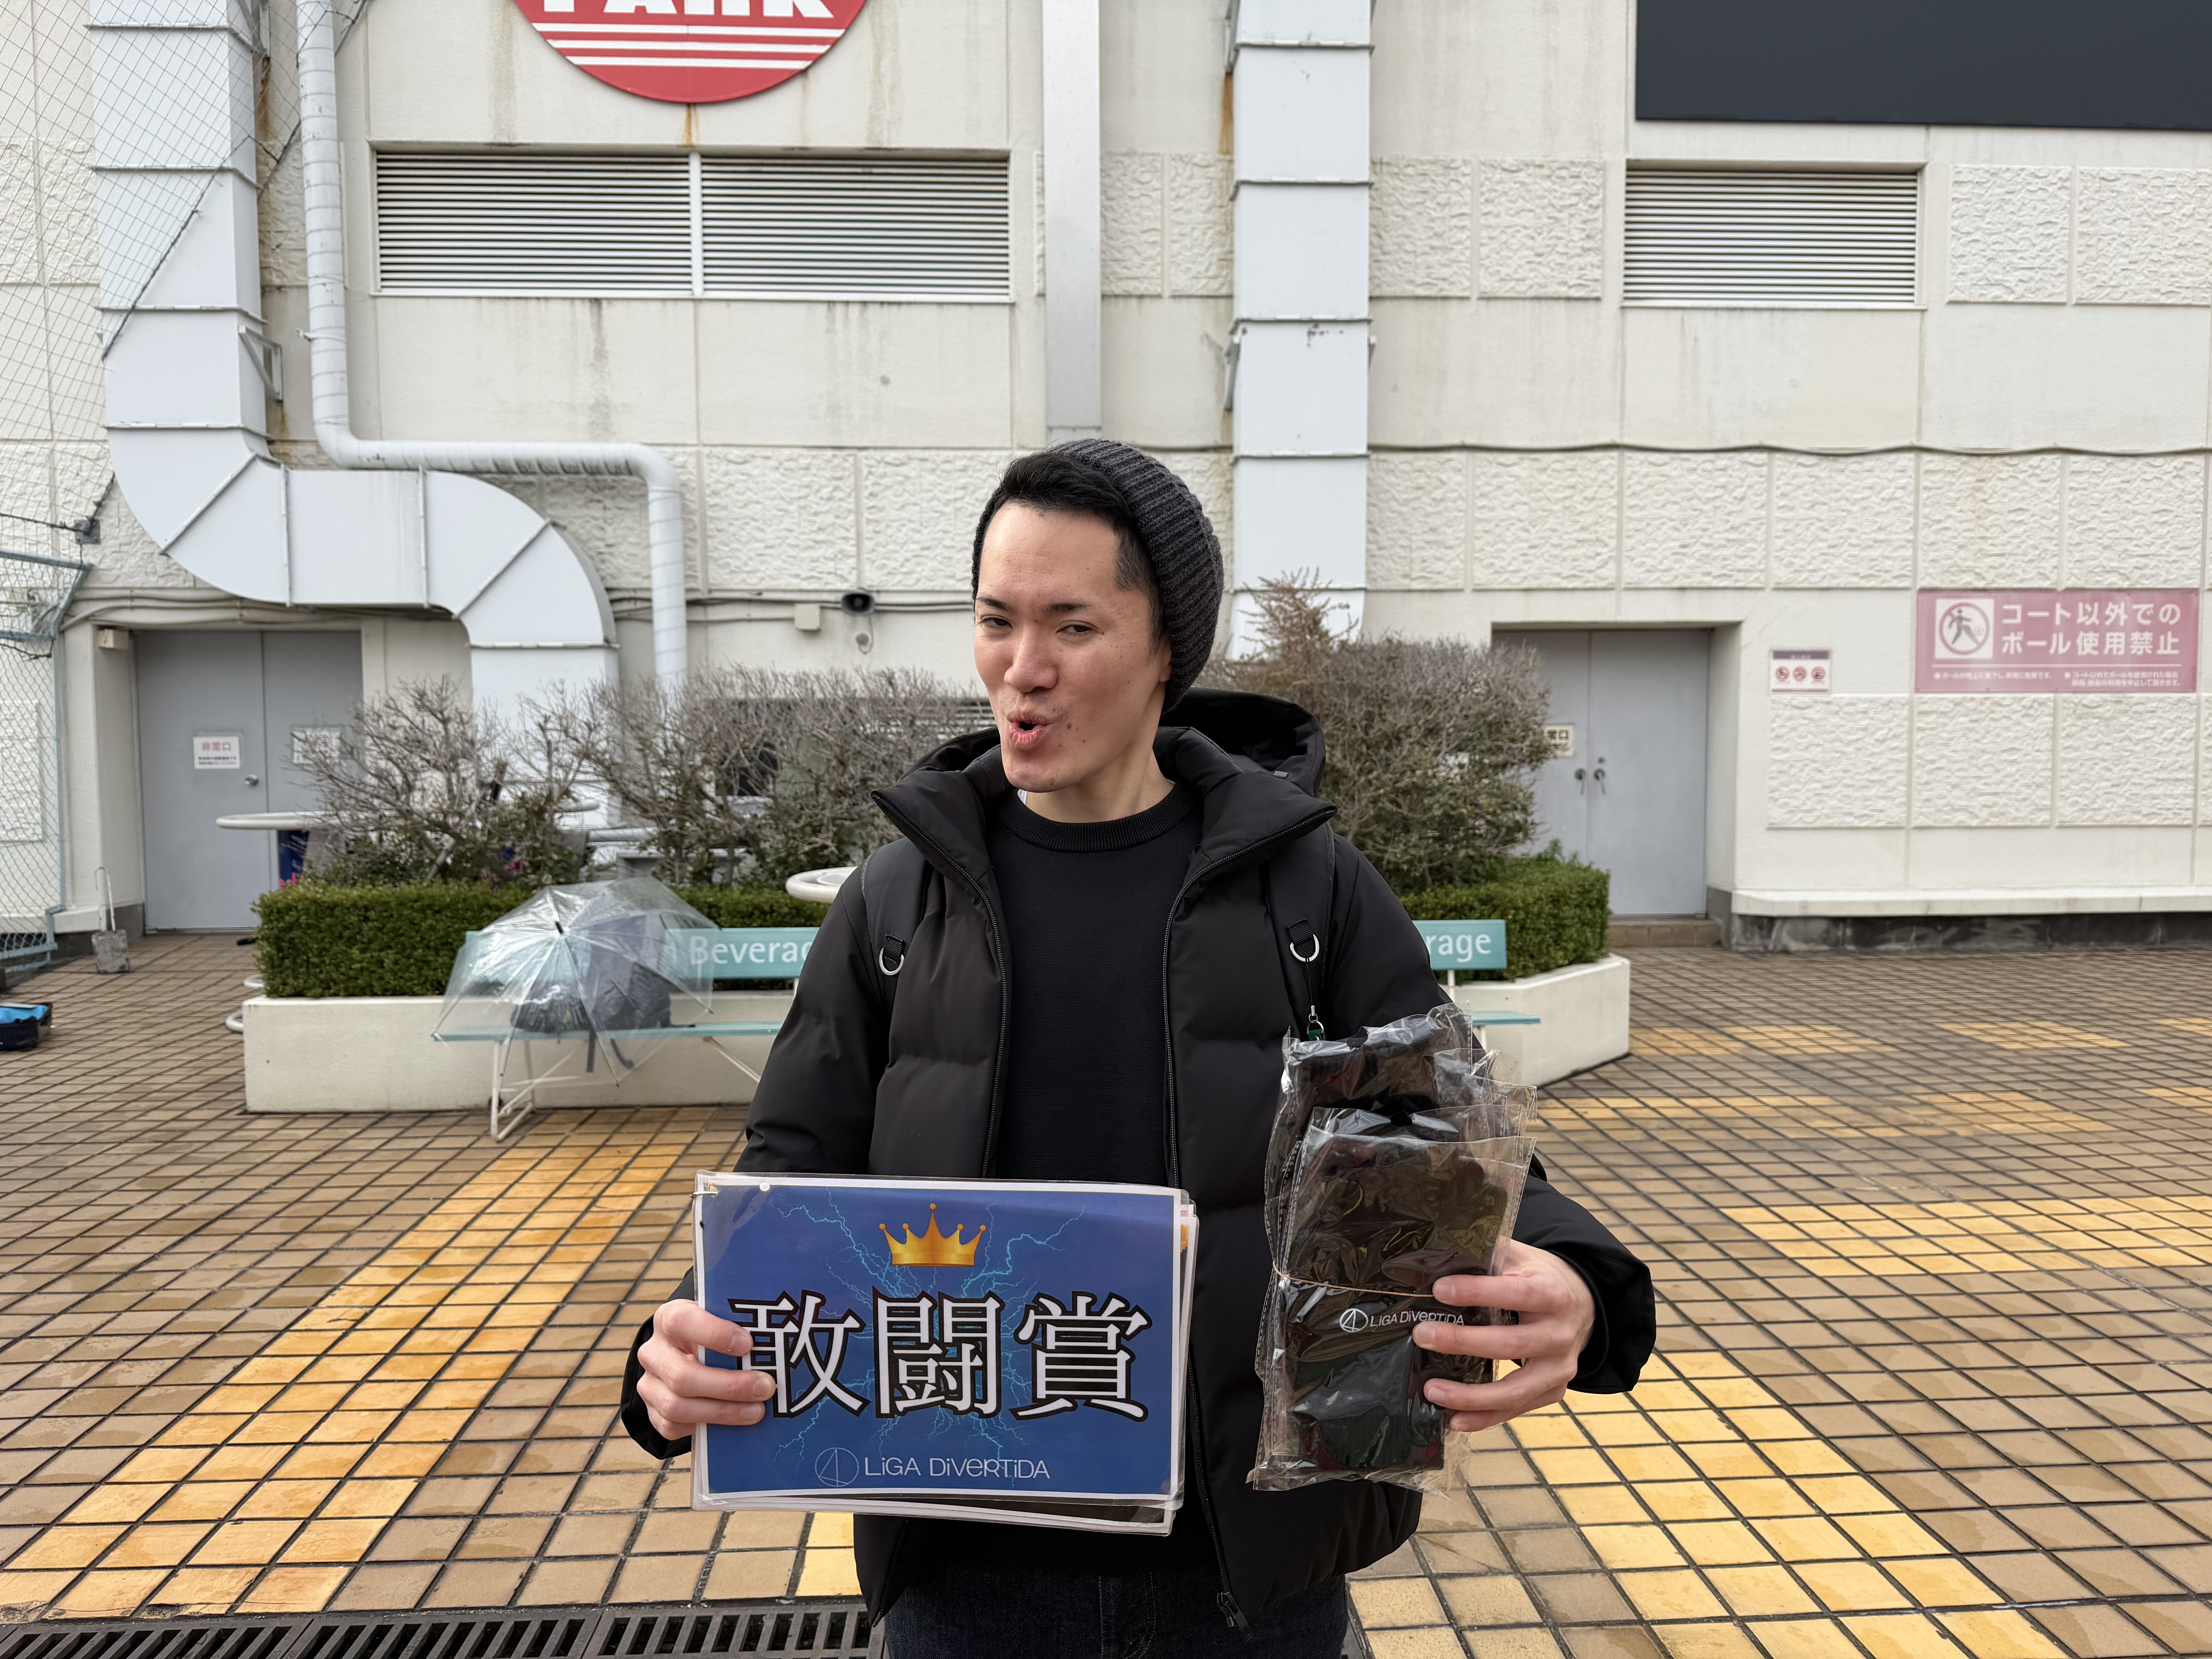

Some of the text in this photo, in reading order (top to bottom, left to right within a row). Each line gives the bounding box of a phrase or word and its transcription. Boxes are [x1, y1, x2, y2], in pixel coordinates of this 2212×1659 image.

[2002, 601, 2181, 626] コート以外での
[2001, 631, 2180, 655] ボール使用禁止
[1425, 933, 1491, 963] rage
[730, 1288, 1152, 1420] 敢闘賞
